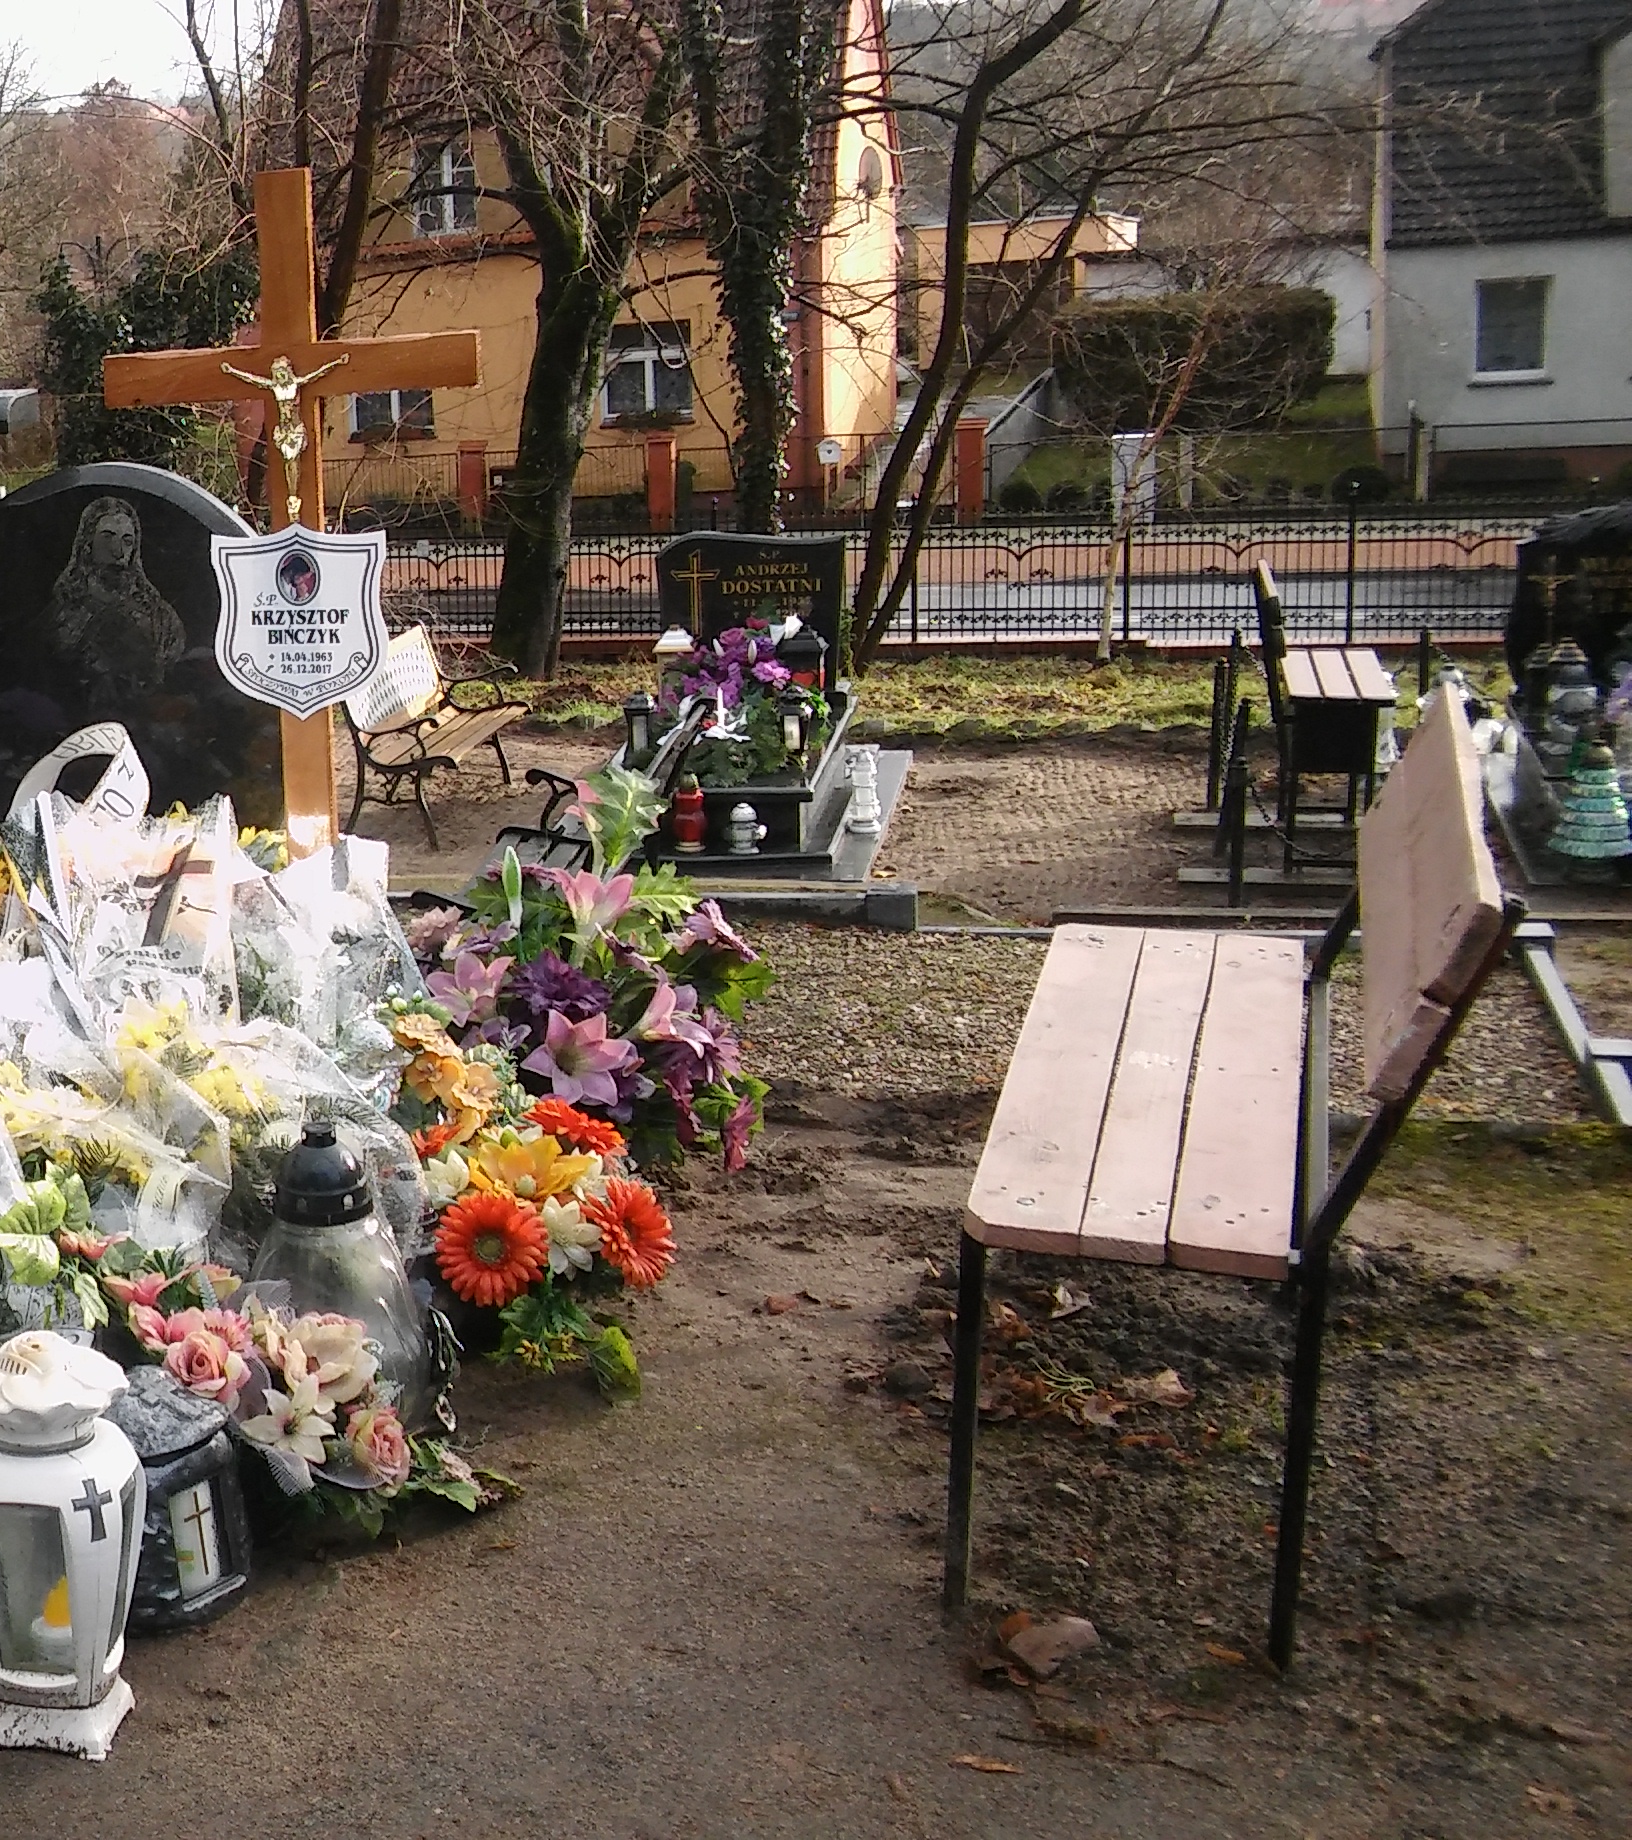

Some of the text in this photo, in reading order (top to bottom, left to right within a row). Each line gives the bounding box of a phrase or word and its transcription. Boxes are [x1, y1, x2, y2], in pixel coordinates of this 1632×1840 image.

[735, 563, 808, 576] ANDRZEJ
[722, 578, 821, 595] DOSTATNI
[251, 608, 350, 625] KRZYSZTOF
[267, 624, 341, 645] BIŃCZYK
[280, 651, 333, 662] 14.04.1963
[280, 663, 332, 674] 26.12.2017
[316, 667, 358, 694] POKOJU
